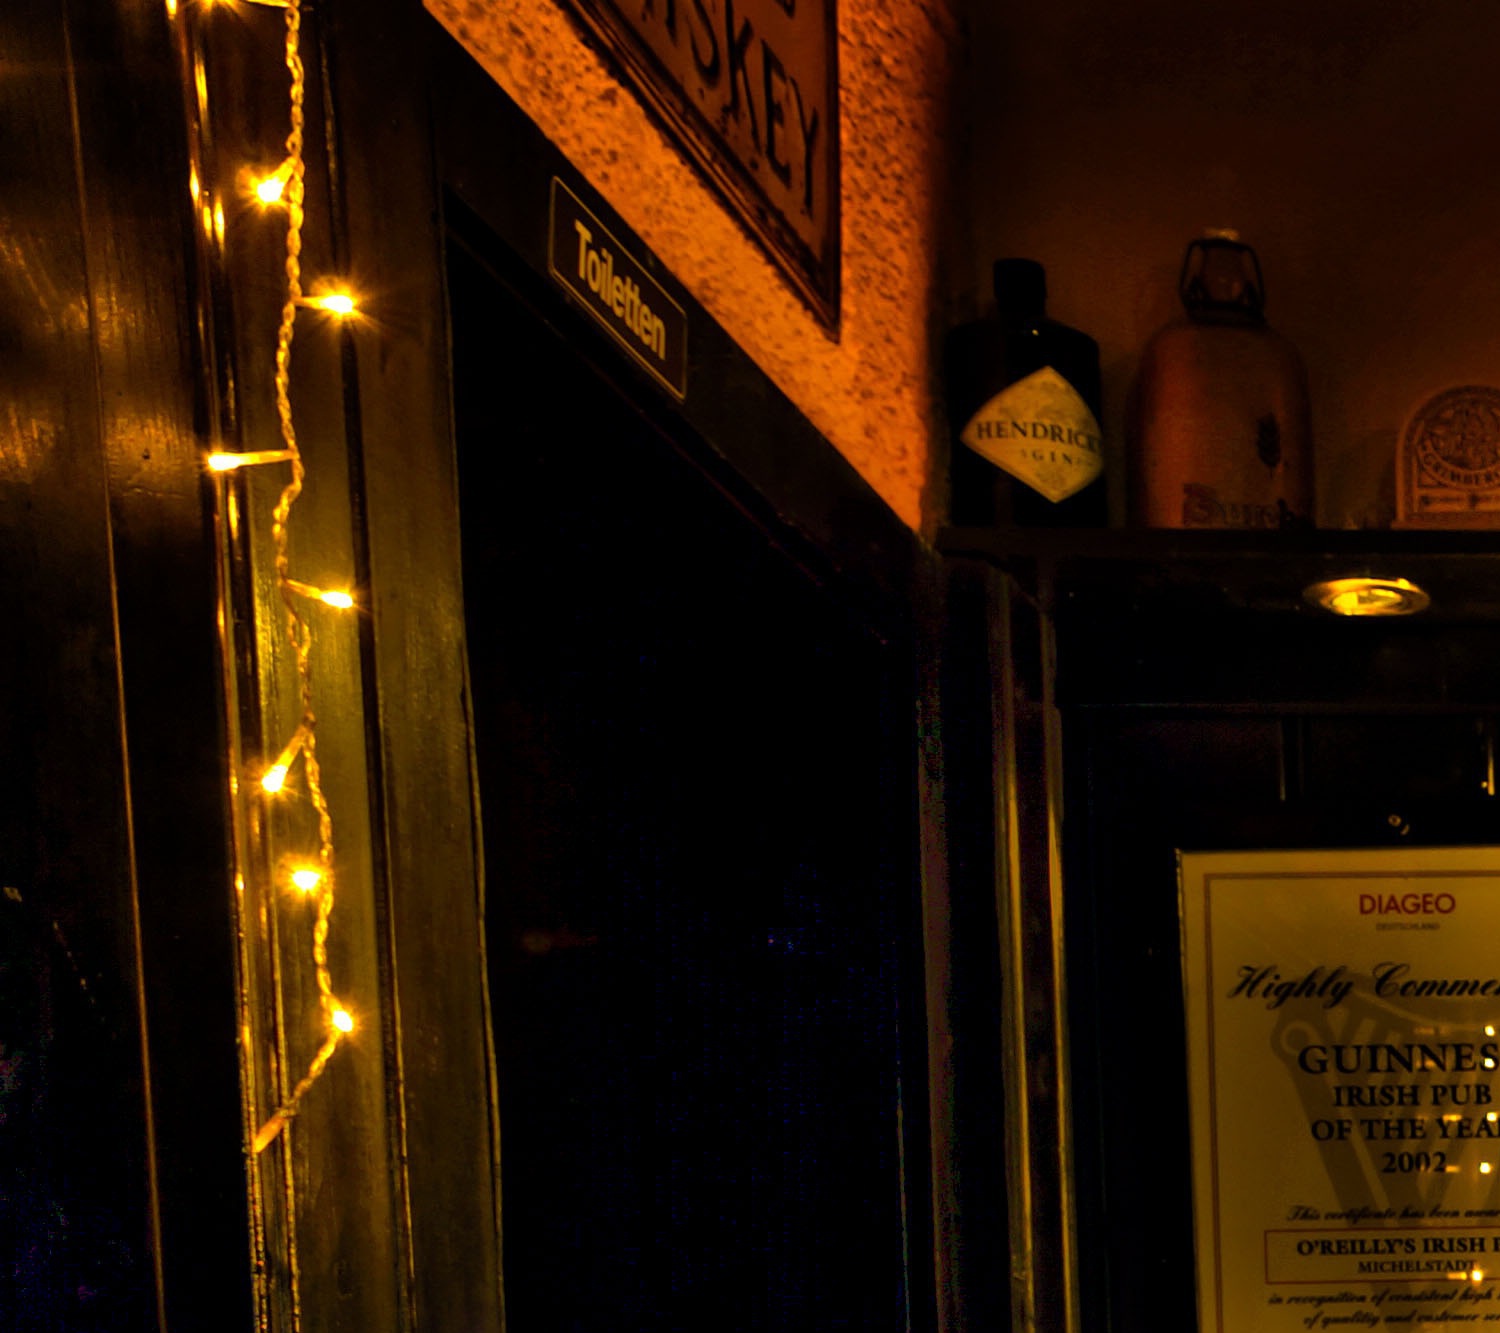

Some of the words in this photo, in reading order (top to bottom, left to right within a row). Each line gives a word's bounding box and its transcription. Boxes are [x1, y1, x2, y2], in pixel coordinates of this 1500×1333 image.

[573, 218, 667, 361] Toiletten
[1358, 892, 1456, 915] DIAGEO
[1227, 963, 1355, 1010] Highly
[1334, 1084, 1418, 1106] IRISH
[1432, 1083, 1492, 1105] PUB
[1311, 1119, 1353, 1141] OF
[1361, 1117, 1426, 1140] THE
[1381, 1151, 1447, 1173] 2002
[1423, 1236, 1486, 1253] IRISH
[1357, 1258, 1478, 1274] MICHELSTADT
